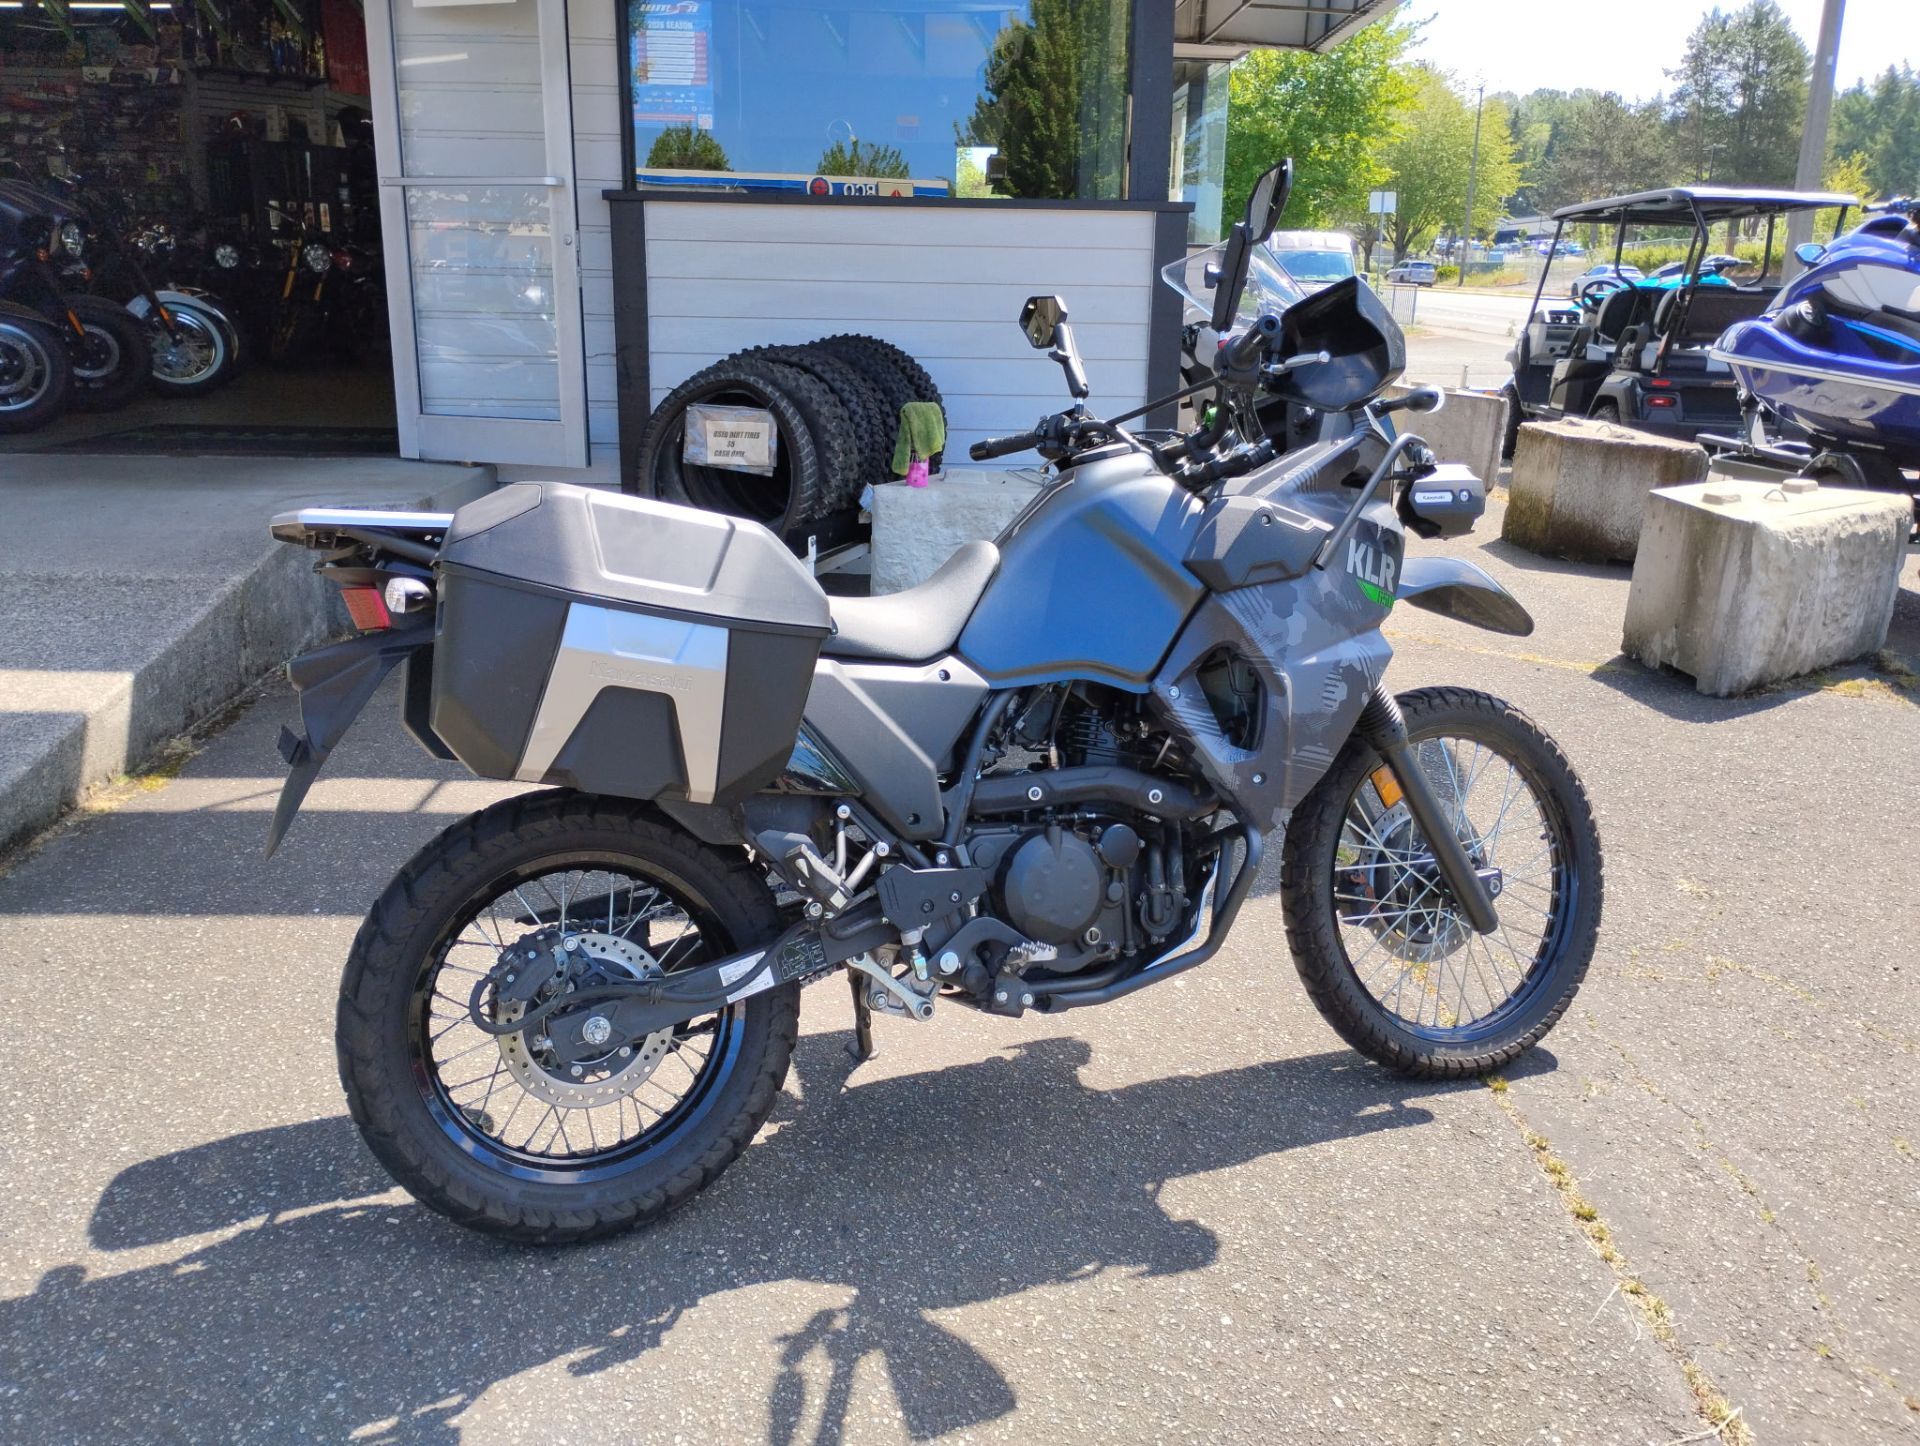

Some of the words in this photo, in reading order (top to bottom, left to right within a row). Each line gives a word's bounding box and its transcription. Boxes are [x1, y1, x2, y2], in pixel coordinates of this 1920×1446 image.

[713, 449, 731, 457] CASH
[1346, 537, 1396, 594] KLR
[589, 658, 695, 691] Kawasaki
